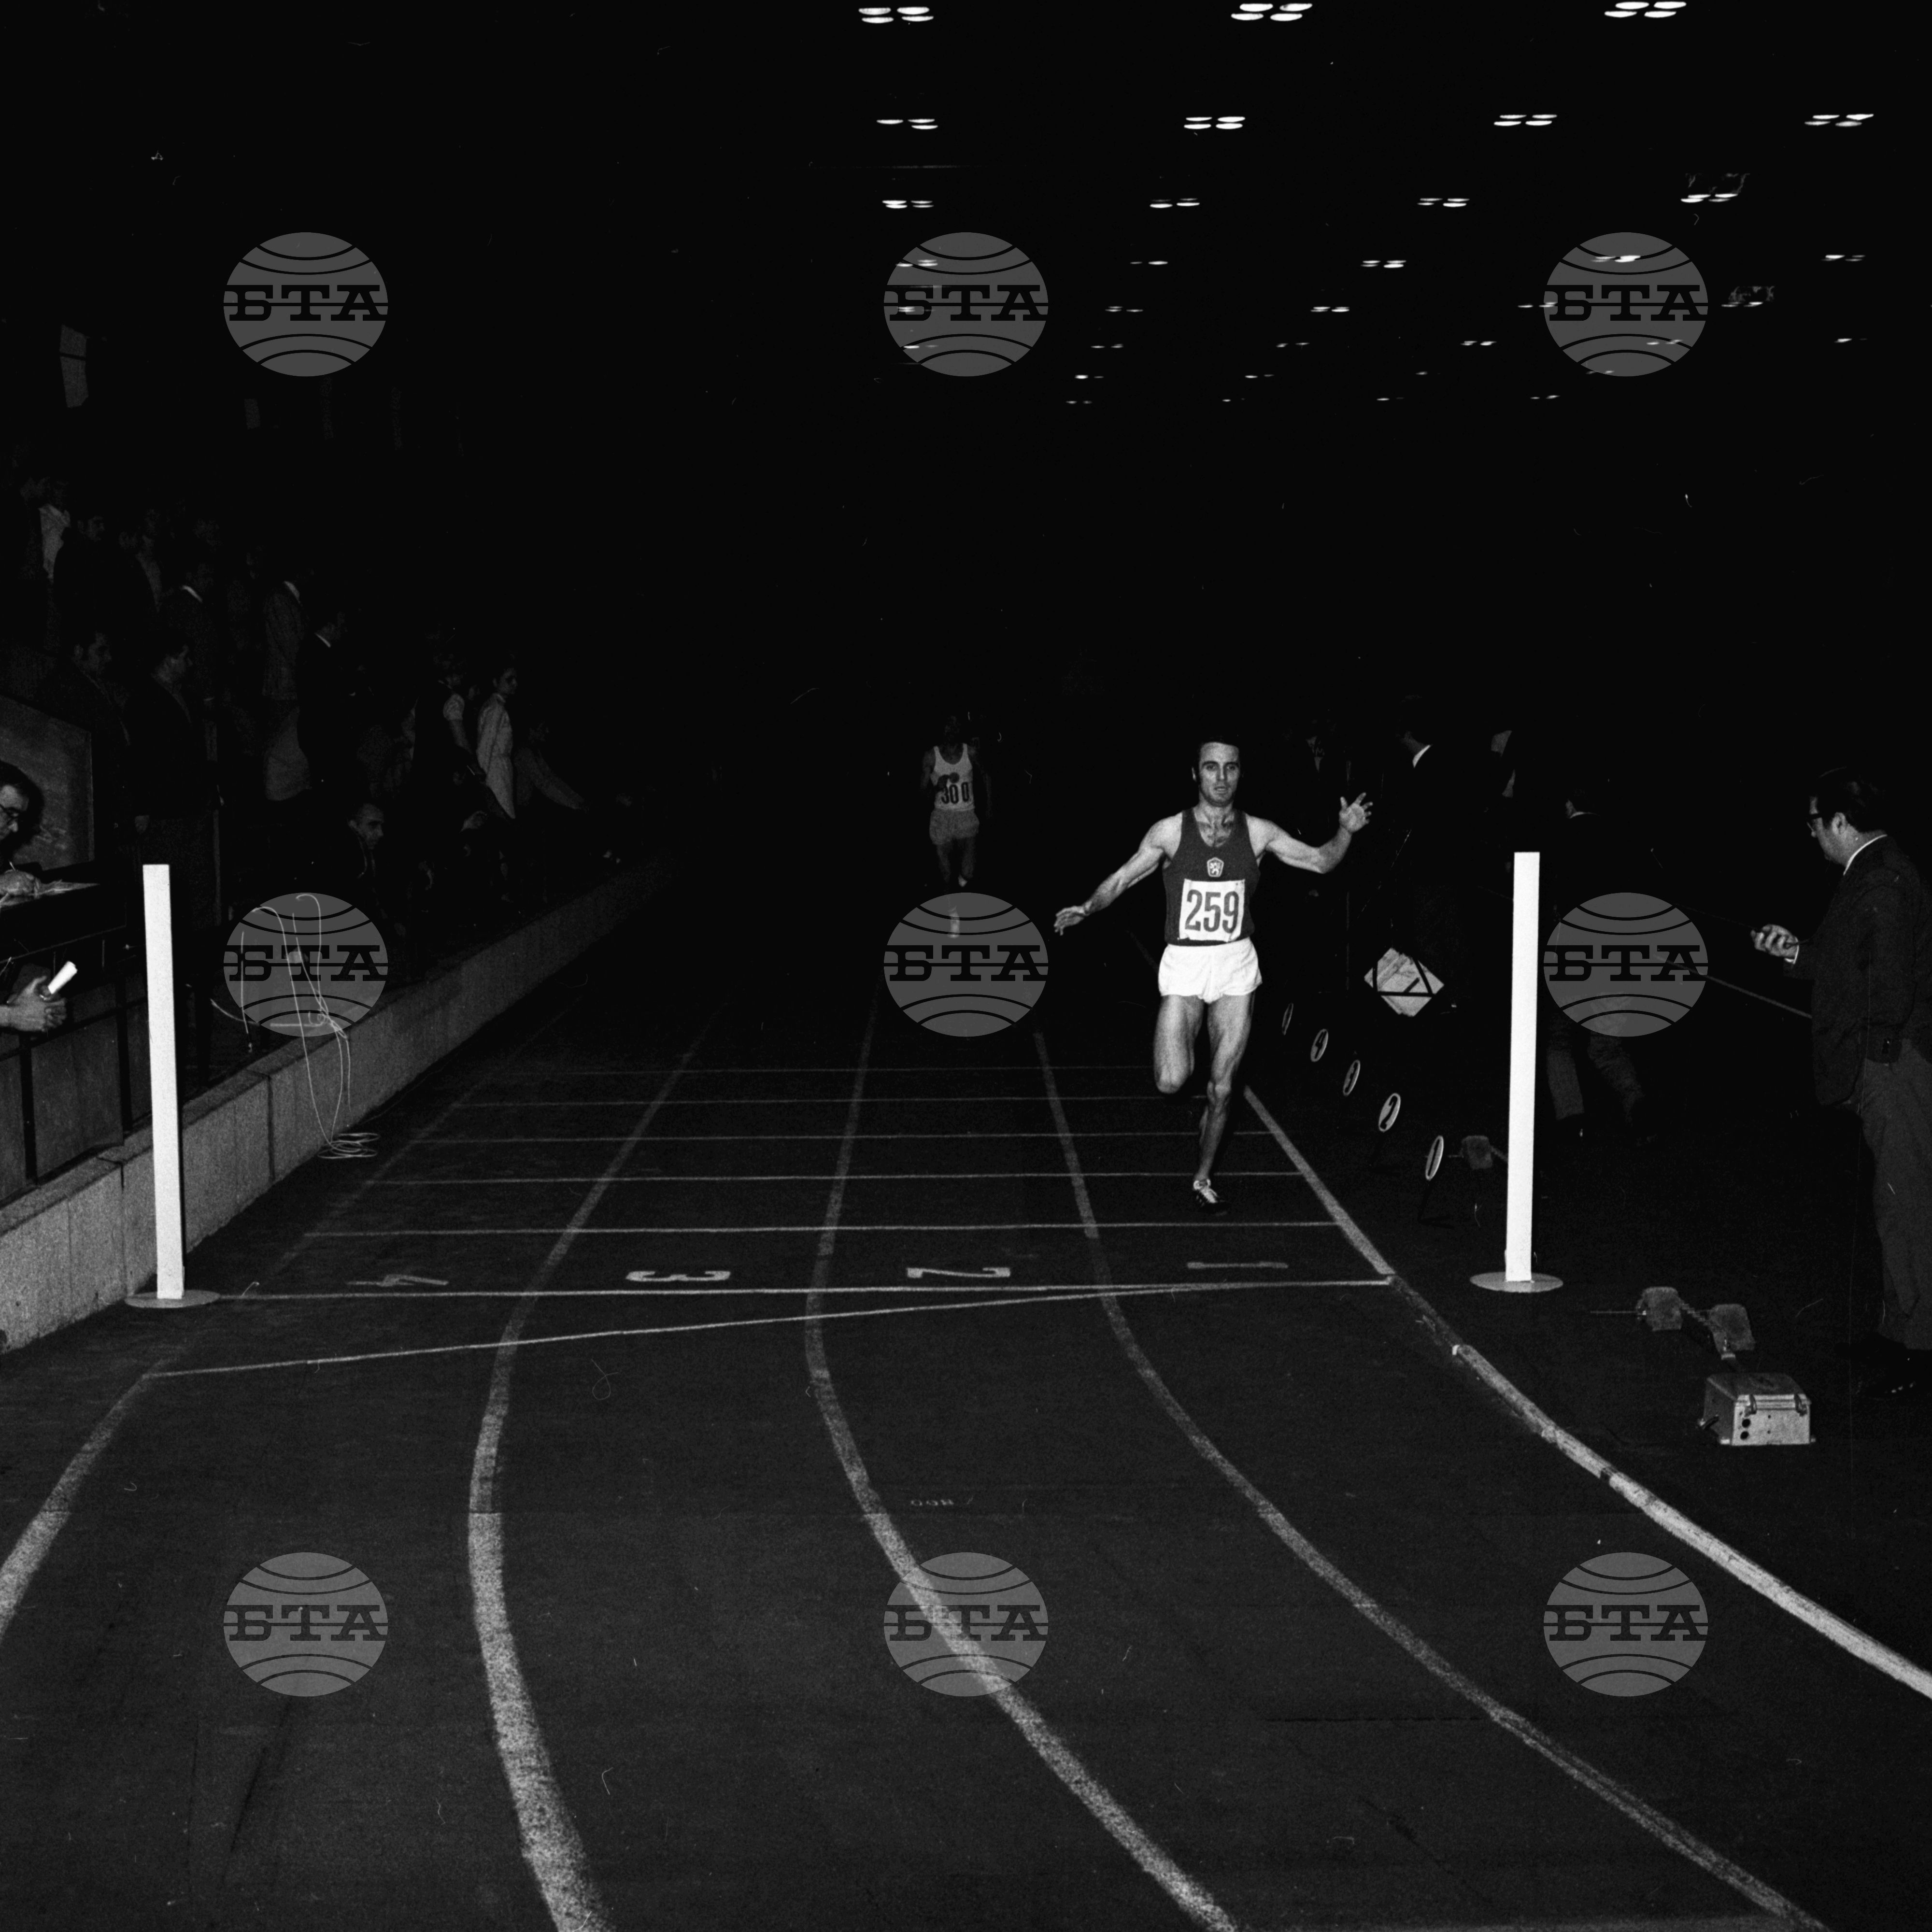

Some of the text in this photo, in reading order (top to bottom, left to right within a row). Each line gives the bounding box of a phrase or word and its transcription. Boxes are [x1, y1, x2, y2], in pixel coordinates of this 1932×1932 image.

[941, 781, 969, 804] 300
[1184, 889, 1239, 933] 259
[1379, 1095, 1398, 1129] 2
[1427, 1140, 1440, 1177] 1
[625, 1270, 731, 1282] 3
[906, 1267, 1010, 1279] 2
